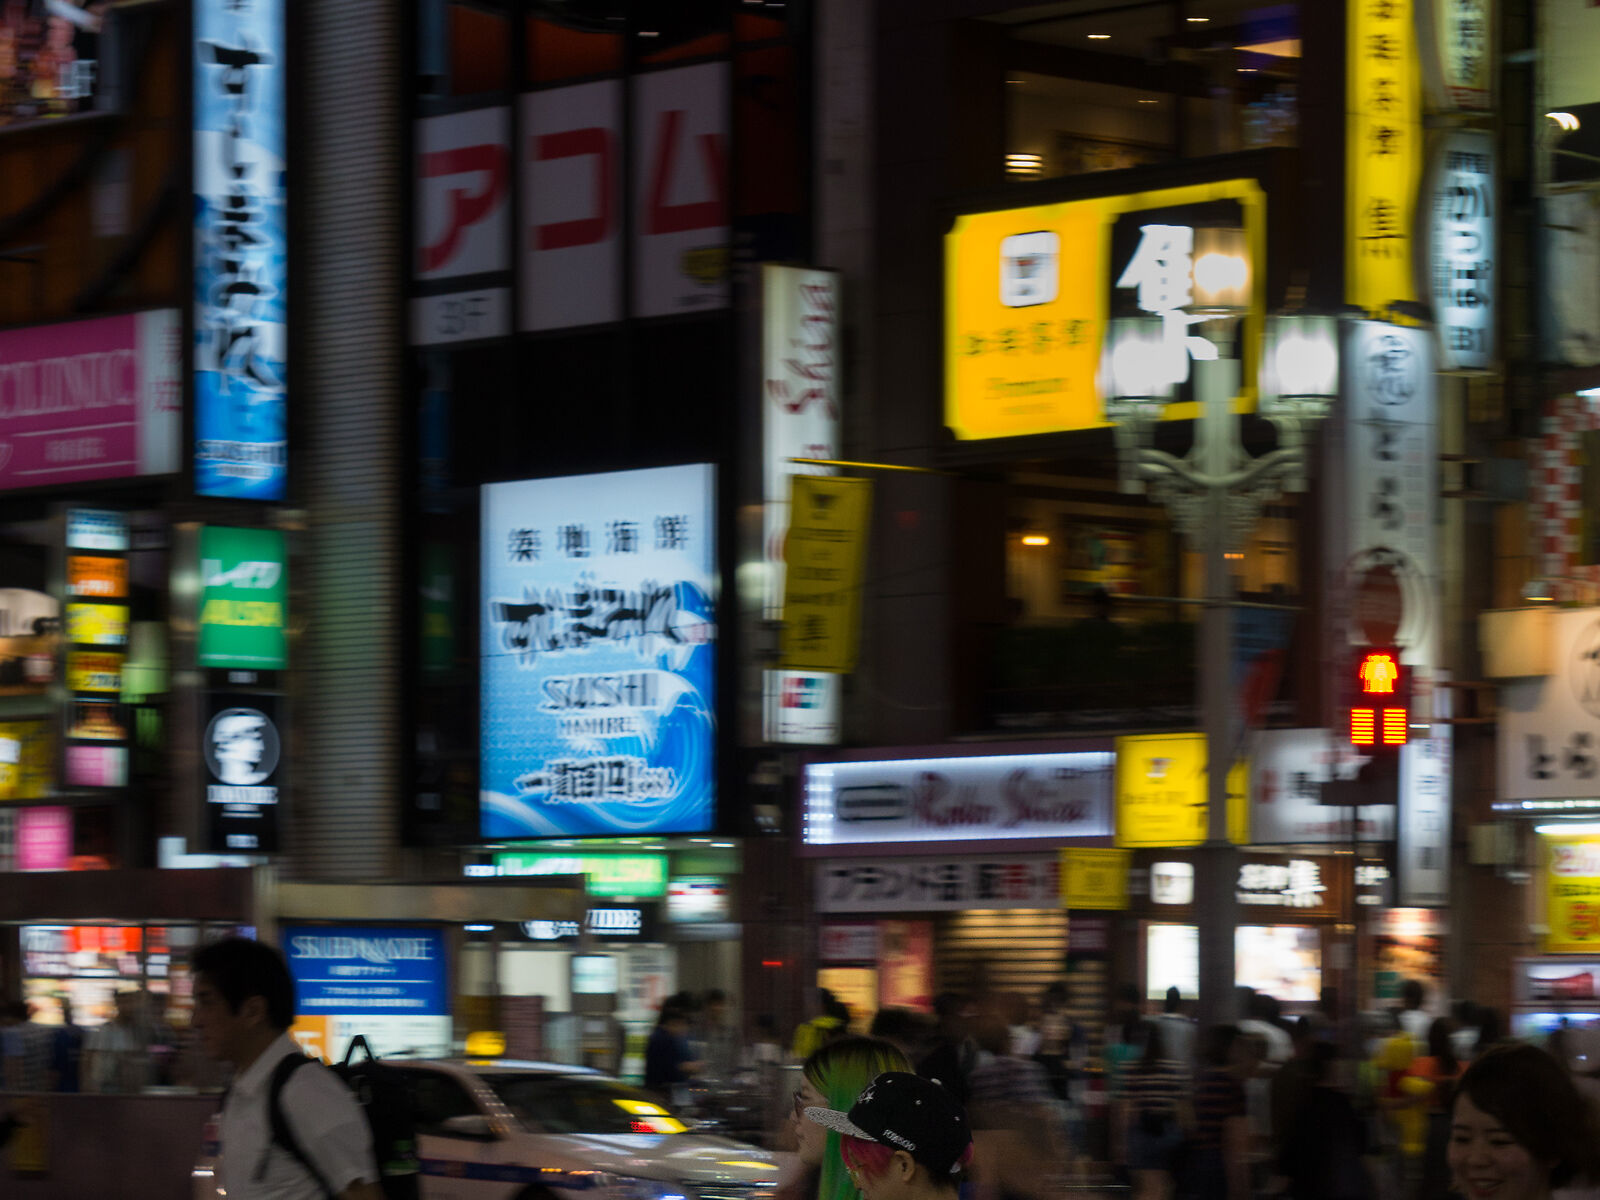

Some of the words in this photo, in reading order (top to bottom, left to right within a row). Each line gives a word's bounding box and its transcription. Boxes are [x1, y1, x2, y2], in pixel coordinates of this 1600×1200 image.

[417, 110, 730, 272] アコム
[540, 672, 659, 711] SUSHI
